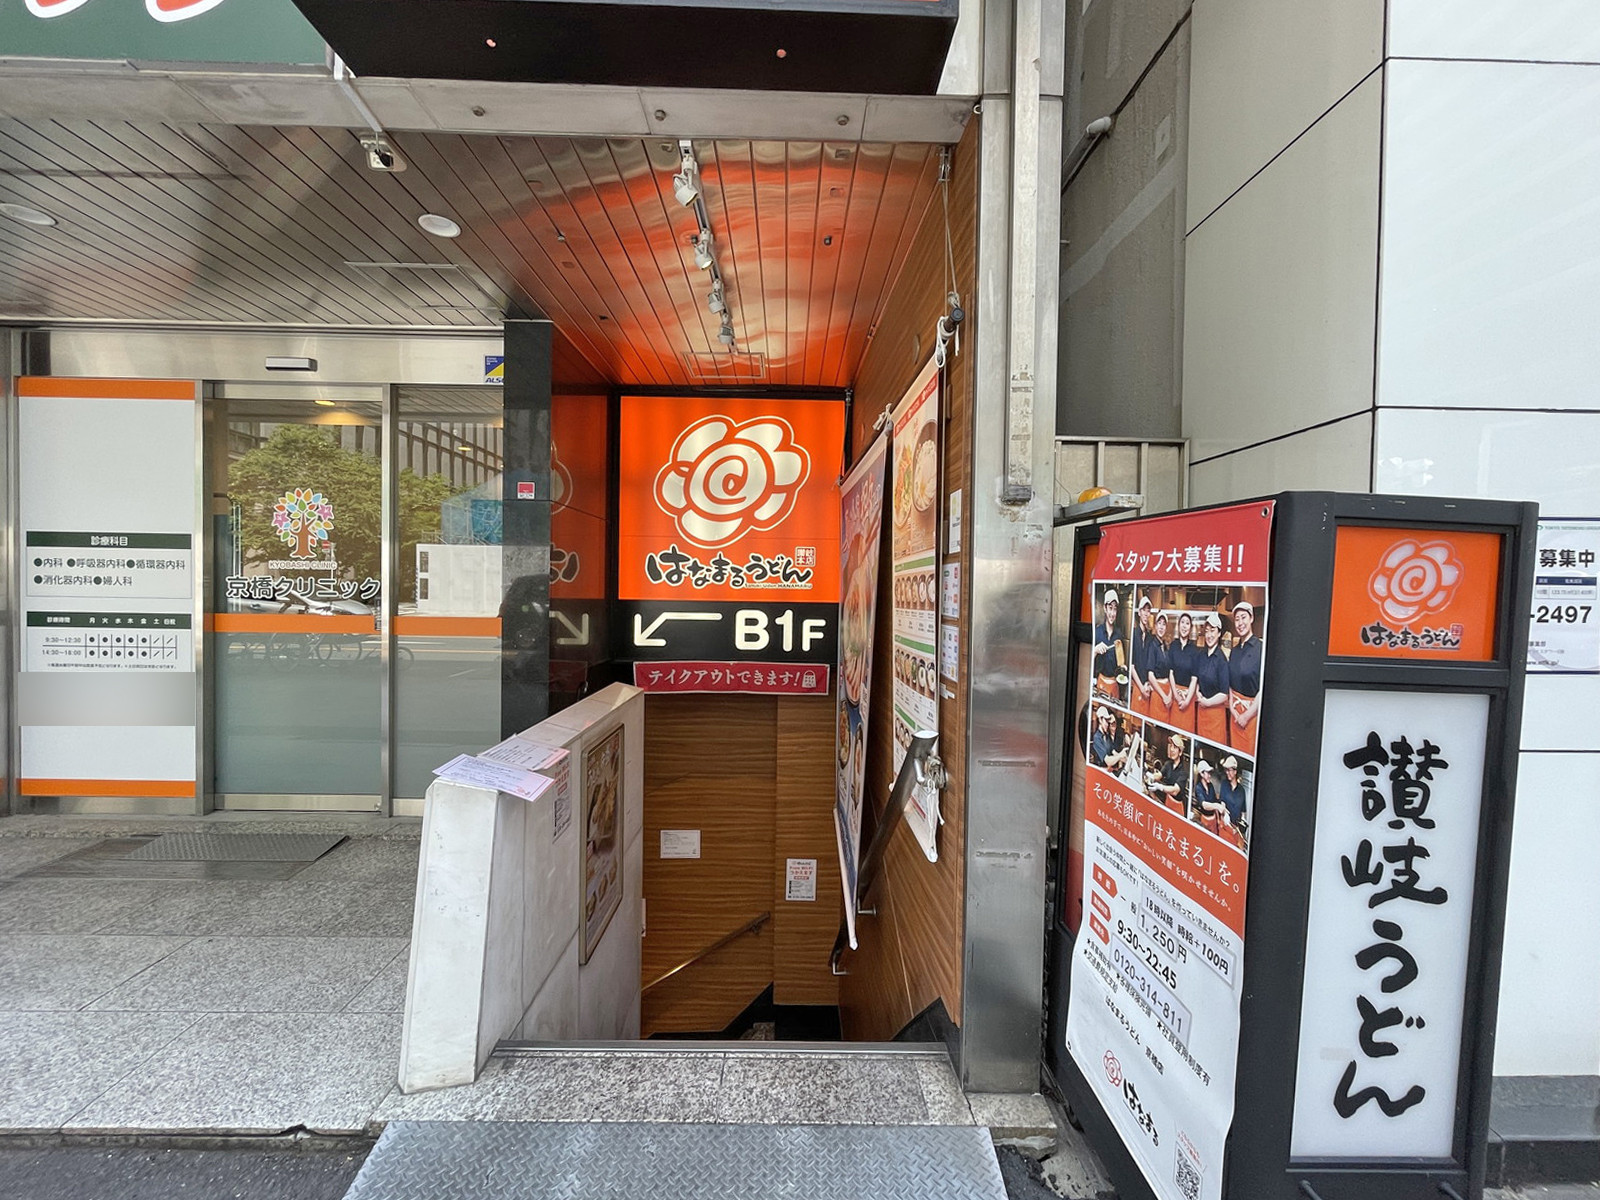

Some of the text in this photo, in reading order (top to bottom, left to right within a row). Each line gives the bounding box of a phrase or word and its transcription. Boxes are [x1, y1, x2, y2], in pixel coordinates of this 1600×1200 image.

[90, 536, 128, 546] 診療科目
[43, 558, 63, 568] 内科
[76, 558, 126, 569] 呼吸器内科
[269, 560, 337, 570] KYOBASHI CLINIC
[646, 544, 813, 588] はなまるうどん
[1539, 549, 1595, 568] 募集中
[43, 575, 93, 586] 消化器内科
[226, 576, 380, 599] 京橋クリニック
[735, 609, 826, 652] B1F
[1361, 621, 1460, 648] はなまるうどん
[1333, 730, 1449, 1119] 讃岐うどん
[1114, 949, 1182, 1033] 0120-314-811
[1123, 1078, 1158, 1146] はなまる
